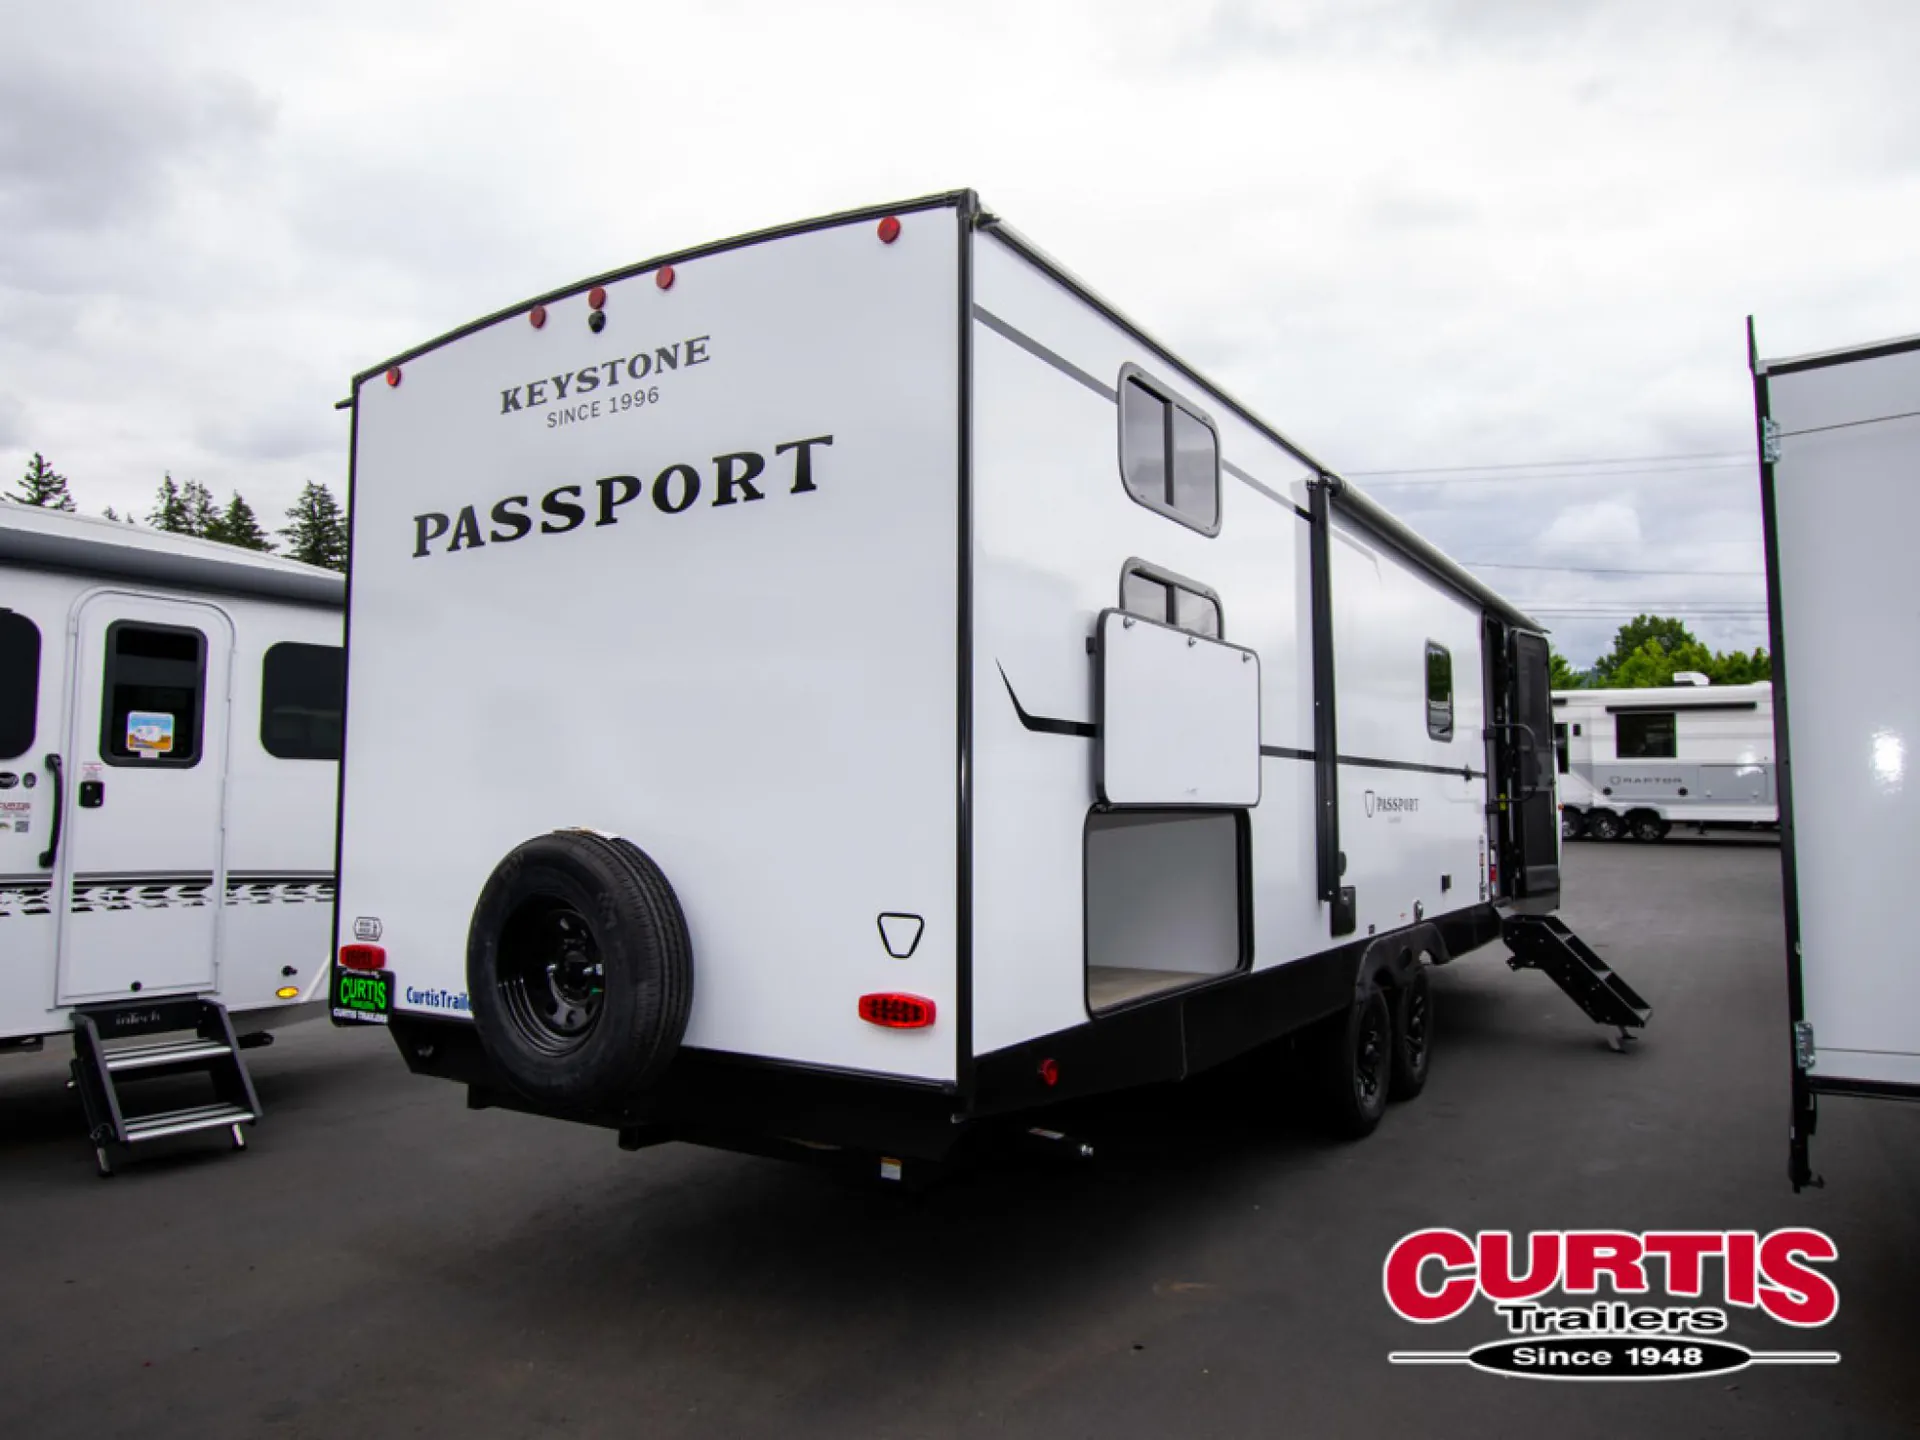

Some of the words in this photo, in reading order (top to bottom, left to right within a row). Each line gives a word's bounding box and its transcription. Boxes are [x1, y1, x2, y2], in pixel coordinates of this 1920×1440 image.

[500, 335, 711, 415] KEYSTONE
[546, 400, 601, 428] SINCE
[608, 386, 660, 414] 1996
[412, 434, 834, 558] PASSPORT
[1622, 776, 1683, 785] RAPTOR
[1376, 797, 1420, 812] PASSPORT
[340, 976, 387, 1010] CURTIS
